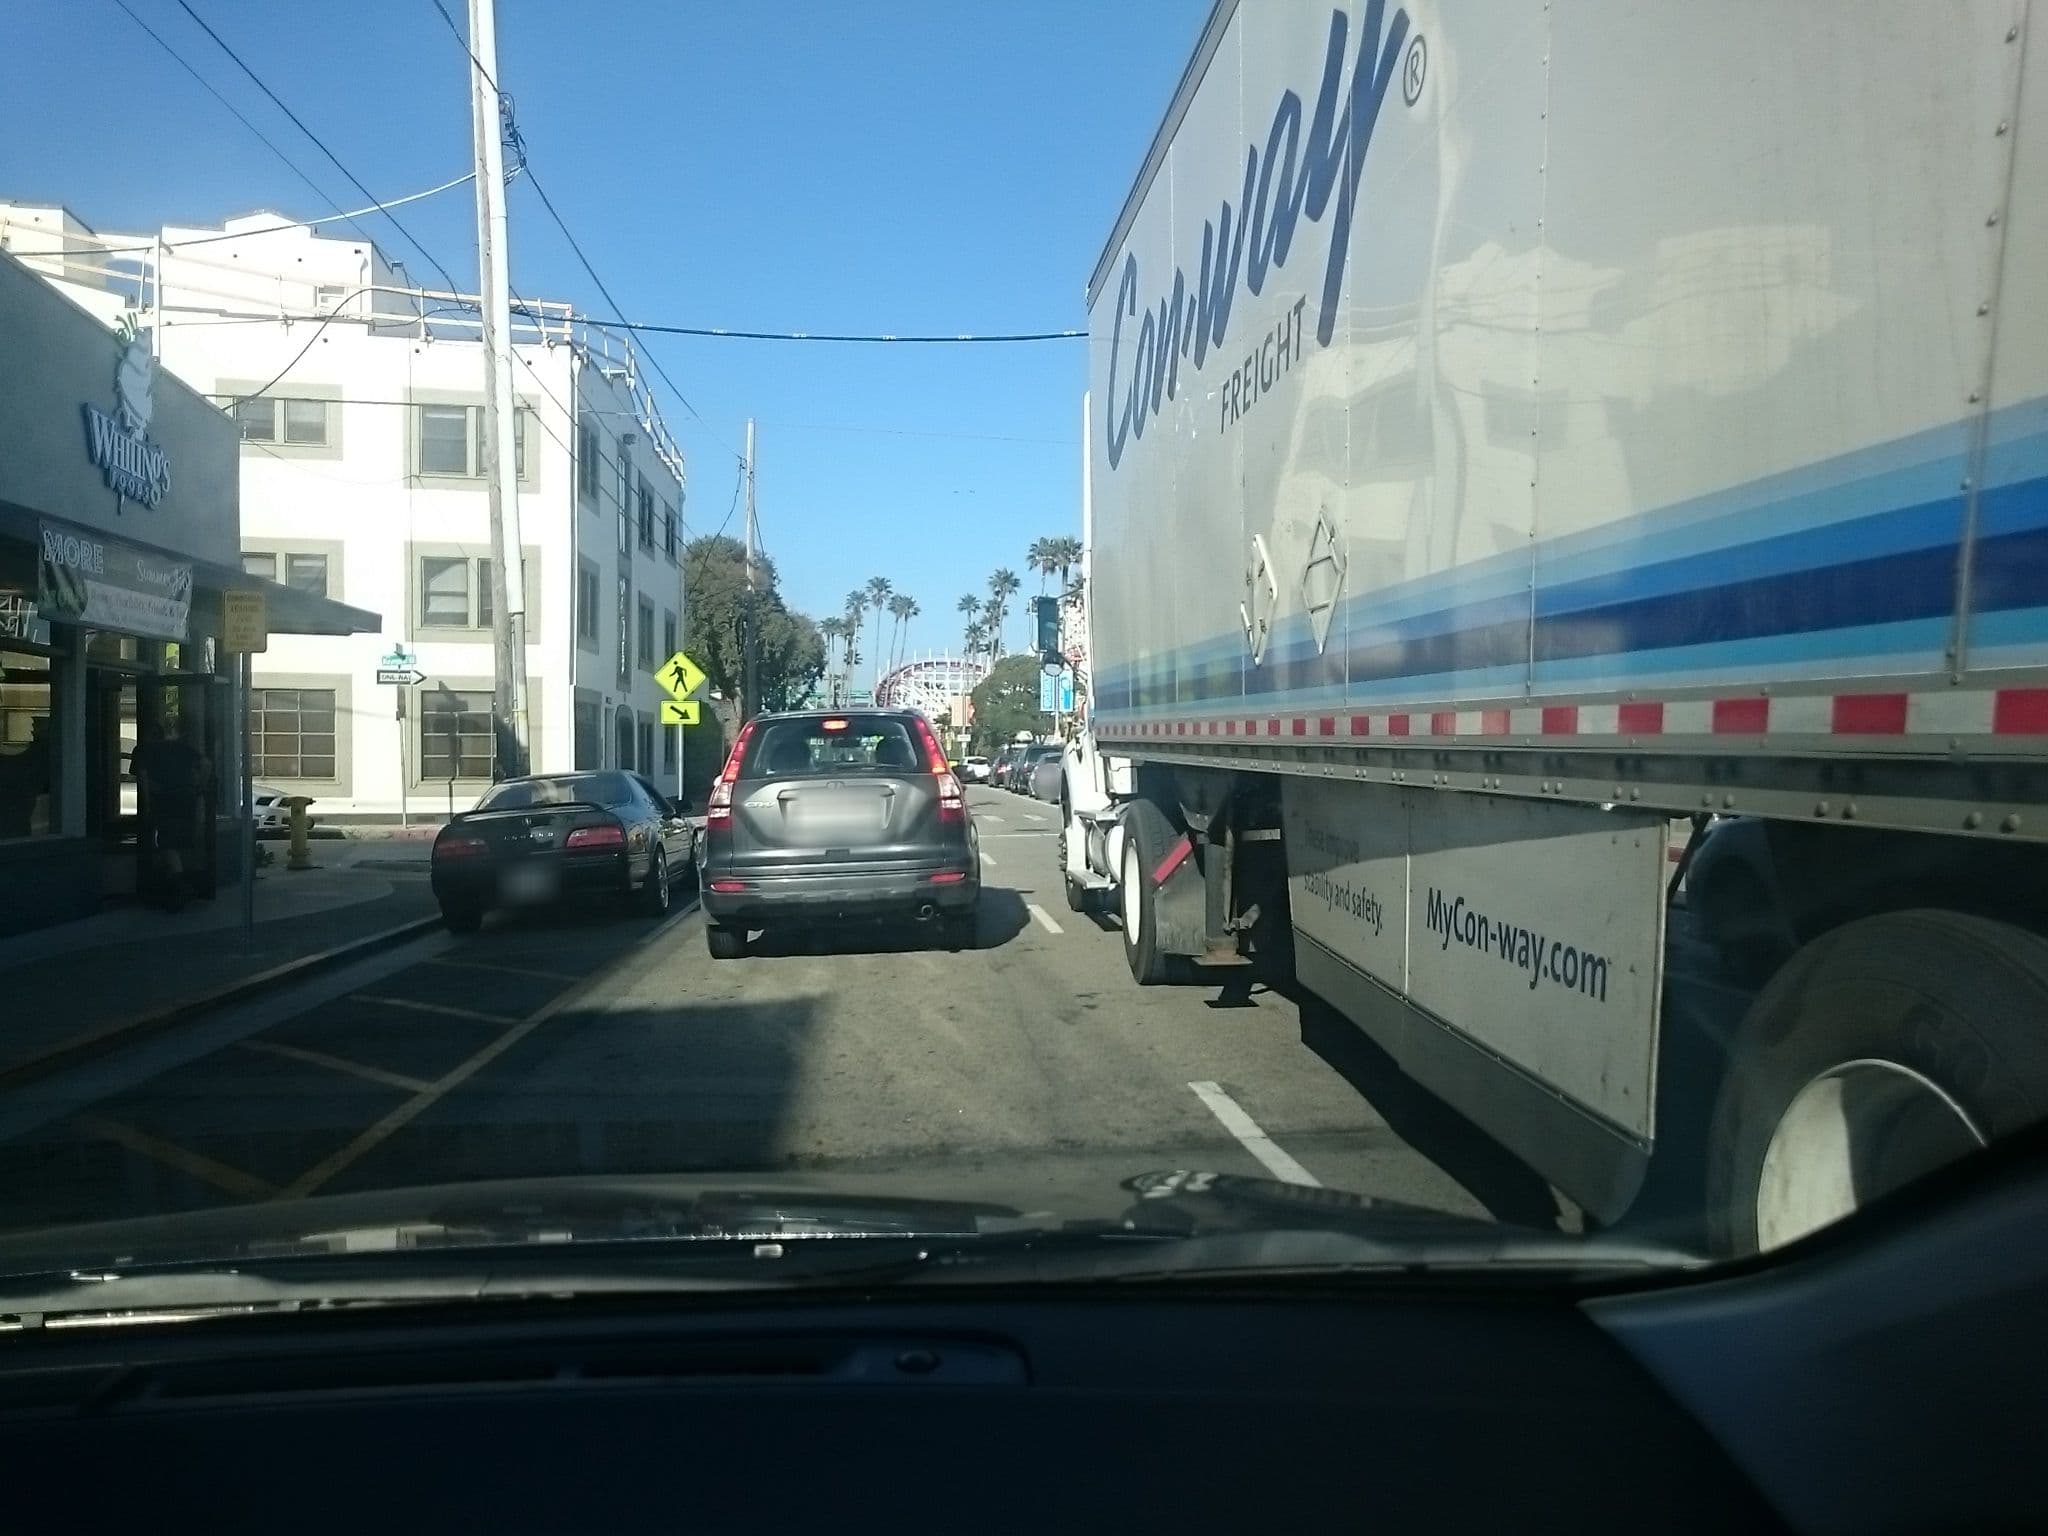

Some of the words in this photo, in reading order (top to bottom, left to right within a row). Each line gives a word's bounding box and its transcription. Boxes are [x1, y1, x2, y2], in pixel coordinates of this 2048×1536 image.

[1220, 293, 1307, 434] FREIGHT
[43, 529, 104, 576] MORE
[1334, 879, 1350, 911] and
[1352, 886, 1383, 937] safety.
[1426, 887, 1608, 1003] MyCon-way.com
